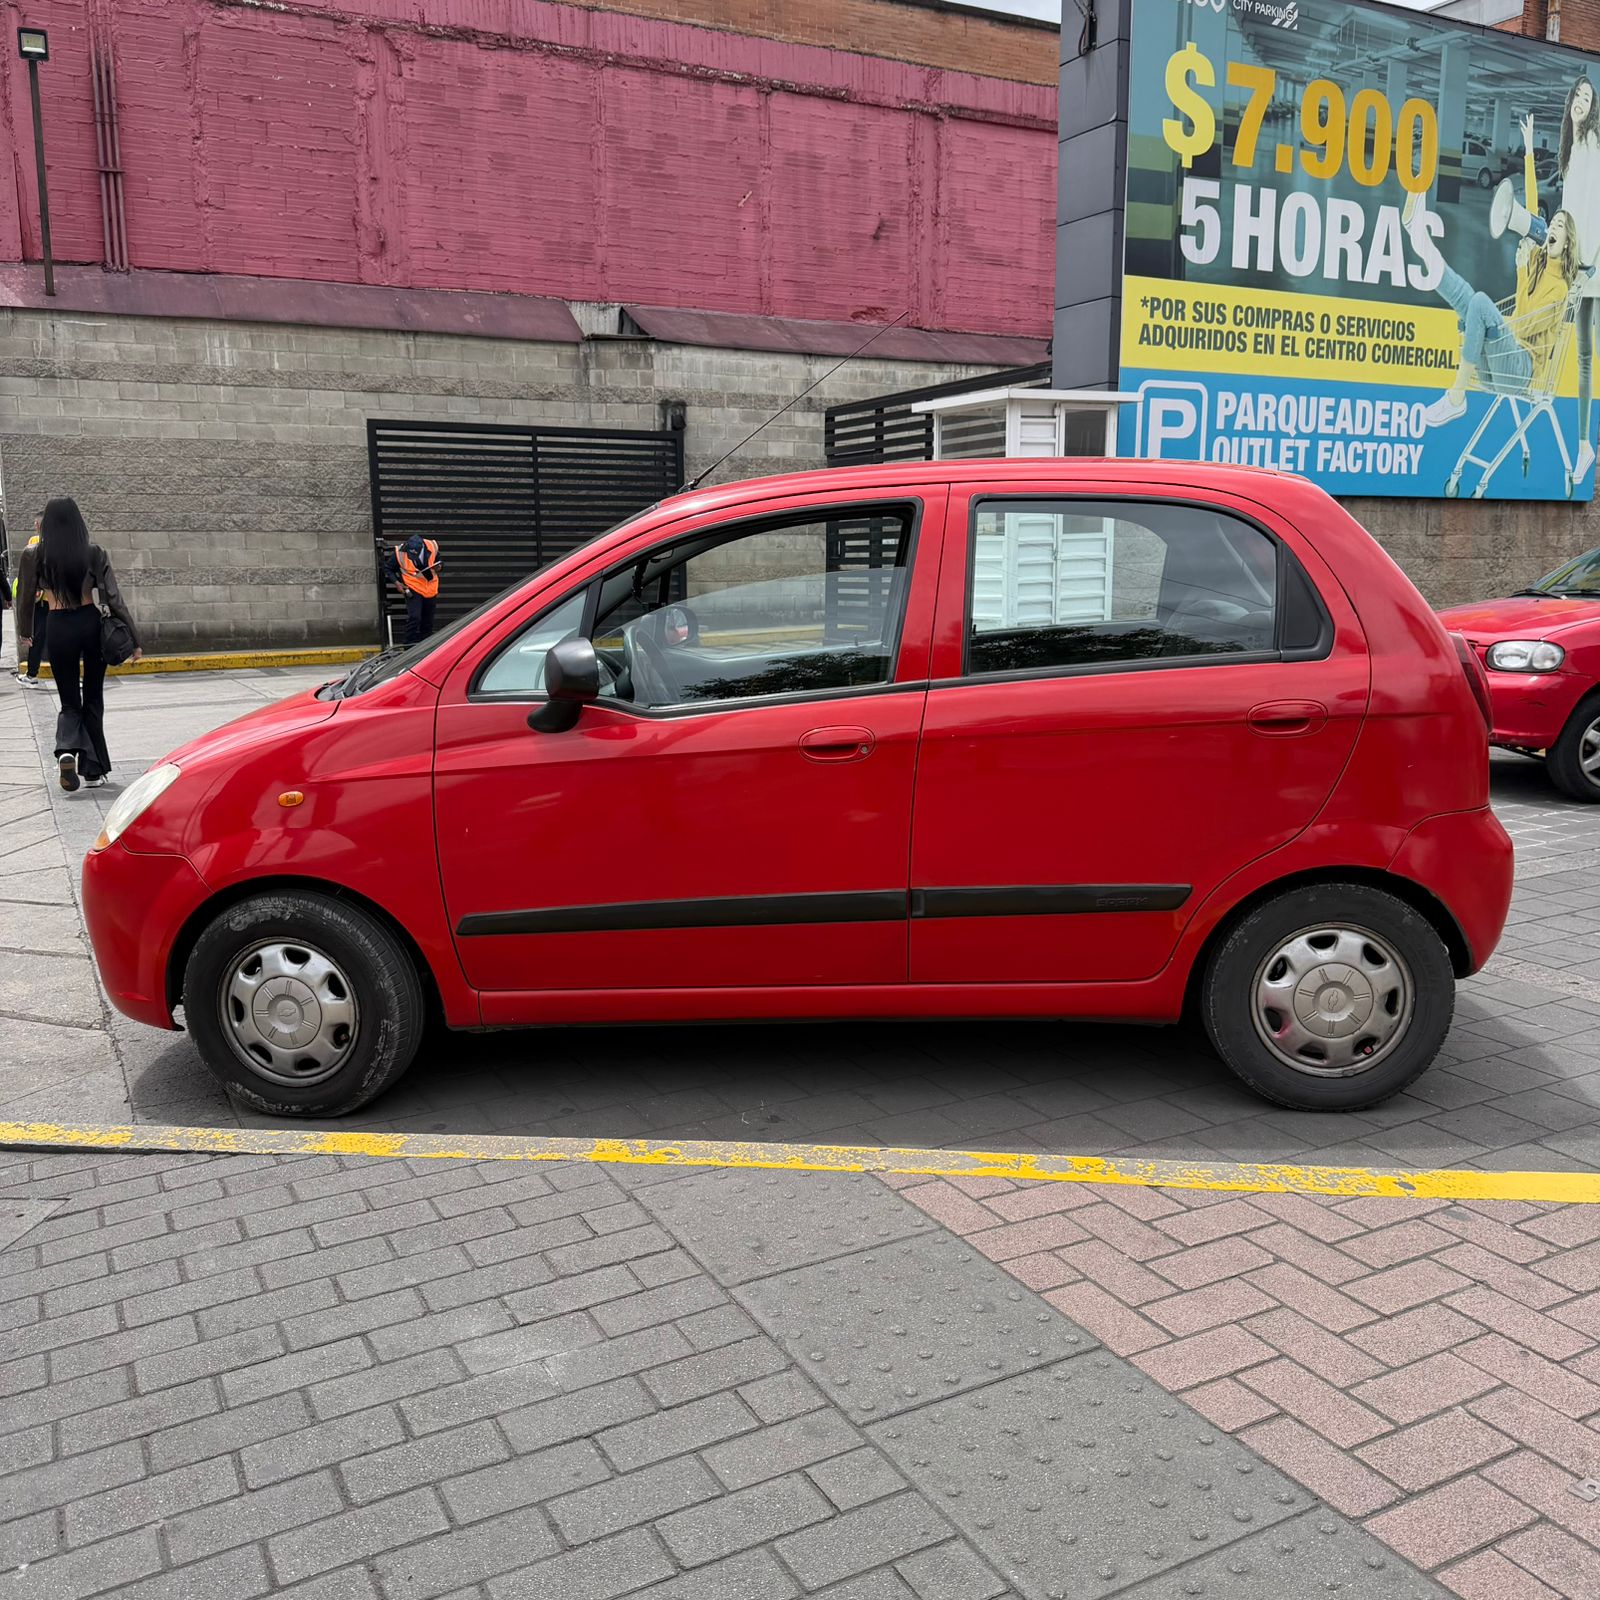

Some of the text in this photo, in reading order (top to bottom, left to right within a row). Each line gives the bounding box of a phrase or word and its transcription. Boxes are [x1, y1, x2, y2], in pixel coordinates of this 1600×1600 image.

[1232, 0, 1253, 13] CITY
[1254, 2, 1295, 21] PARKING
[1179, 176, 1446, 291] 5 HORAS
[1192, 301, 1227, 325] SUS
[1232, 304, 1315, 333] COMPRAS
[1320, 313, 1331, 334] O
[1336, 314, 1415, 342] SERVICIOS
[1138, 323, 1460, 371] ADQUIRIDOS EN EL CENTRO COMERCIAL.
[1216, 391, 1427, 439] PARQUEADERO
[1212, 436, 1424, 475] OUTLET FACTORY
